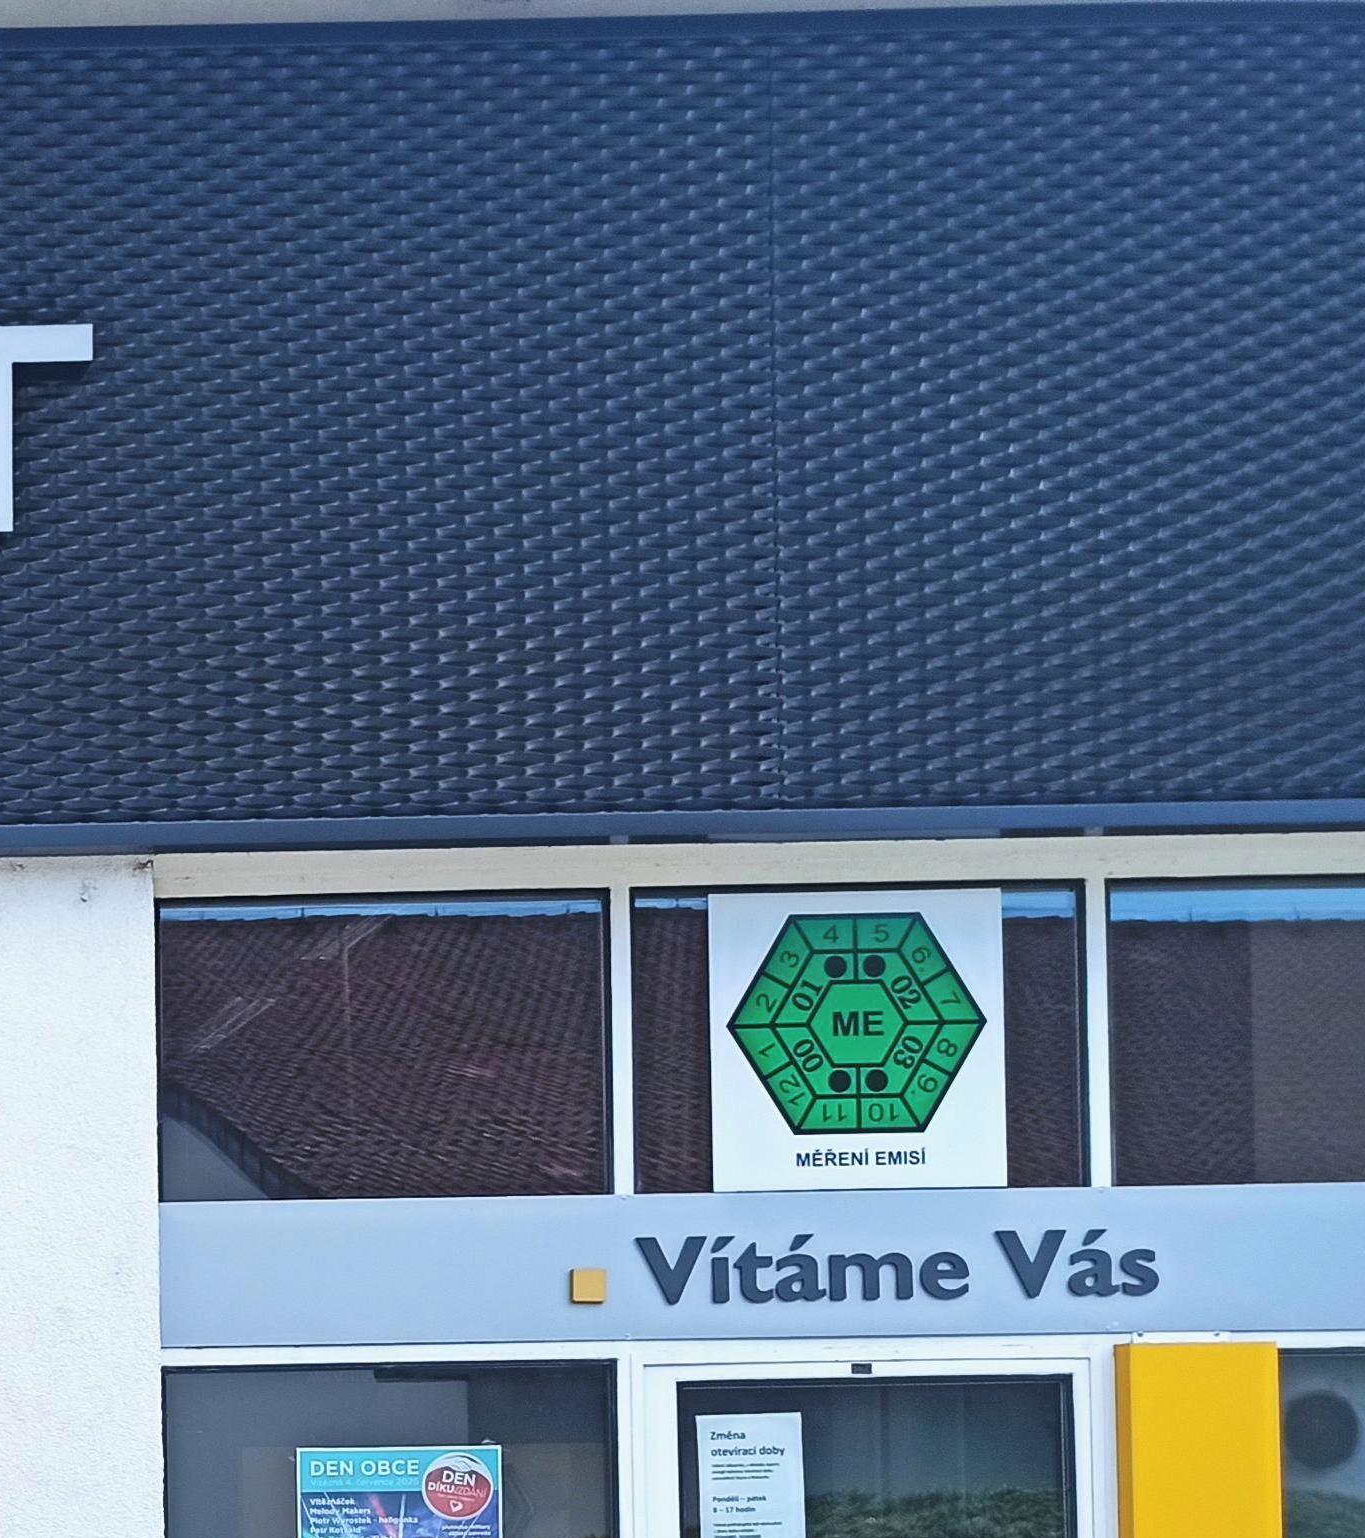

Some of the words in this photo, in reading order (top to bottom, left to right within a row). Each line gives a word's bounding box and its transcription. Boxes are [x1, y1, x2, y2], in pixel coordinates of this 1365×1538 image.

[823, 925, 839, 942] 4
[874, 924, 890, 941] 5
[780, 950, 801, 968] 3
[792, 981, 823, 1012] 01
[892, 975, 921, 1010] 02
[755, 992, 778, 1012] 2
[832, 1011, 884, 1036] ME
[793, 1039, 824, 1072] 00
[893, 1036, 924, 1070] 03
[936, 1039, 958, 1056] 8
[795, 1148, 869, 1167] MĚŘENÍ
[875, 1147, 926, 1166] EMISÍ
[634, 1233, 970, 1305] Vítáme
[994, 1228, 1160, 1299] Vás
[710, 1431, 746, 1440] Změna
[759, 1446, 785, 1456] doby
[310, 1460, 353, 1476] DEN
[360, 1460, 420, 1476] OBCE
[442, 1470, 476, 1488] DEN
[342, 1507, 371, 1515] Makers
